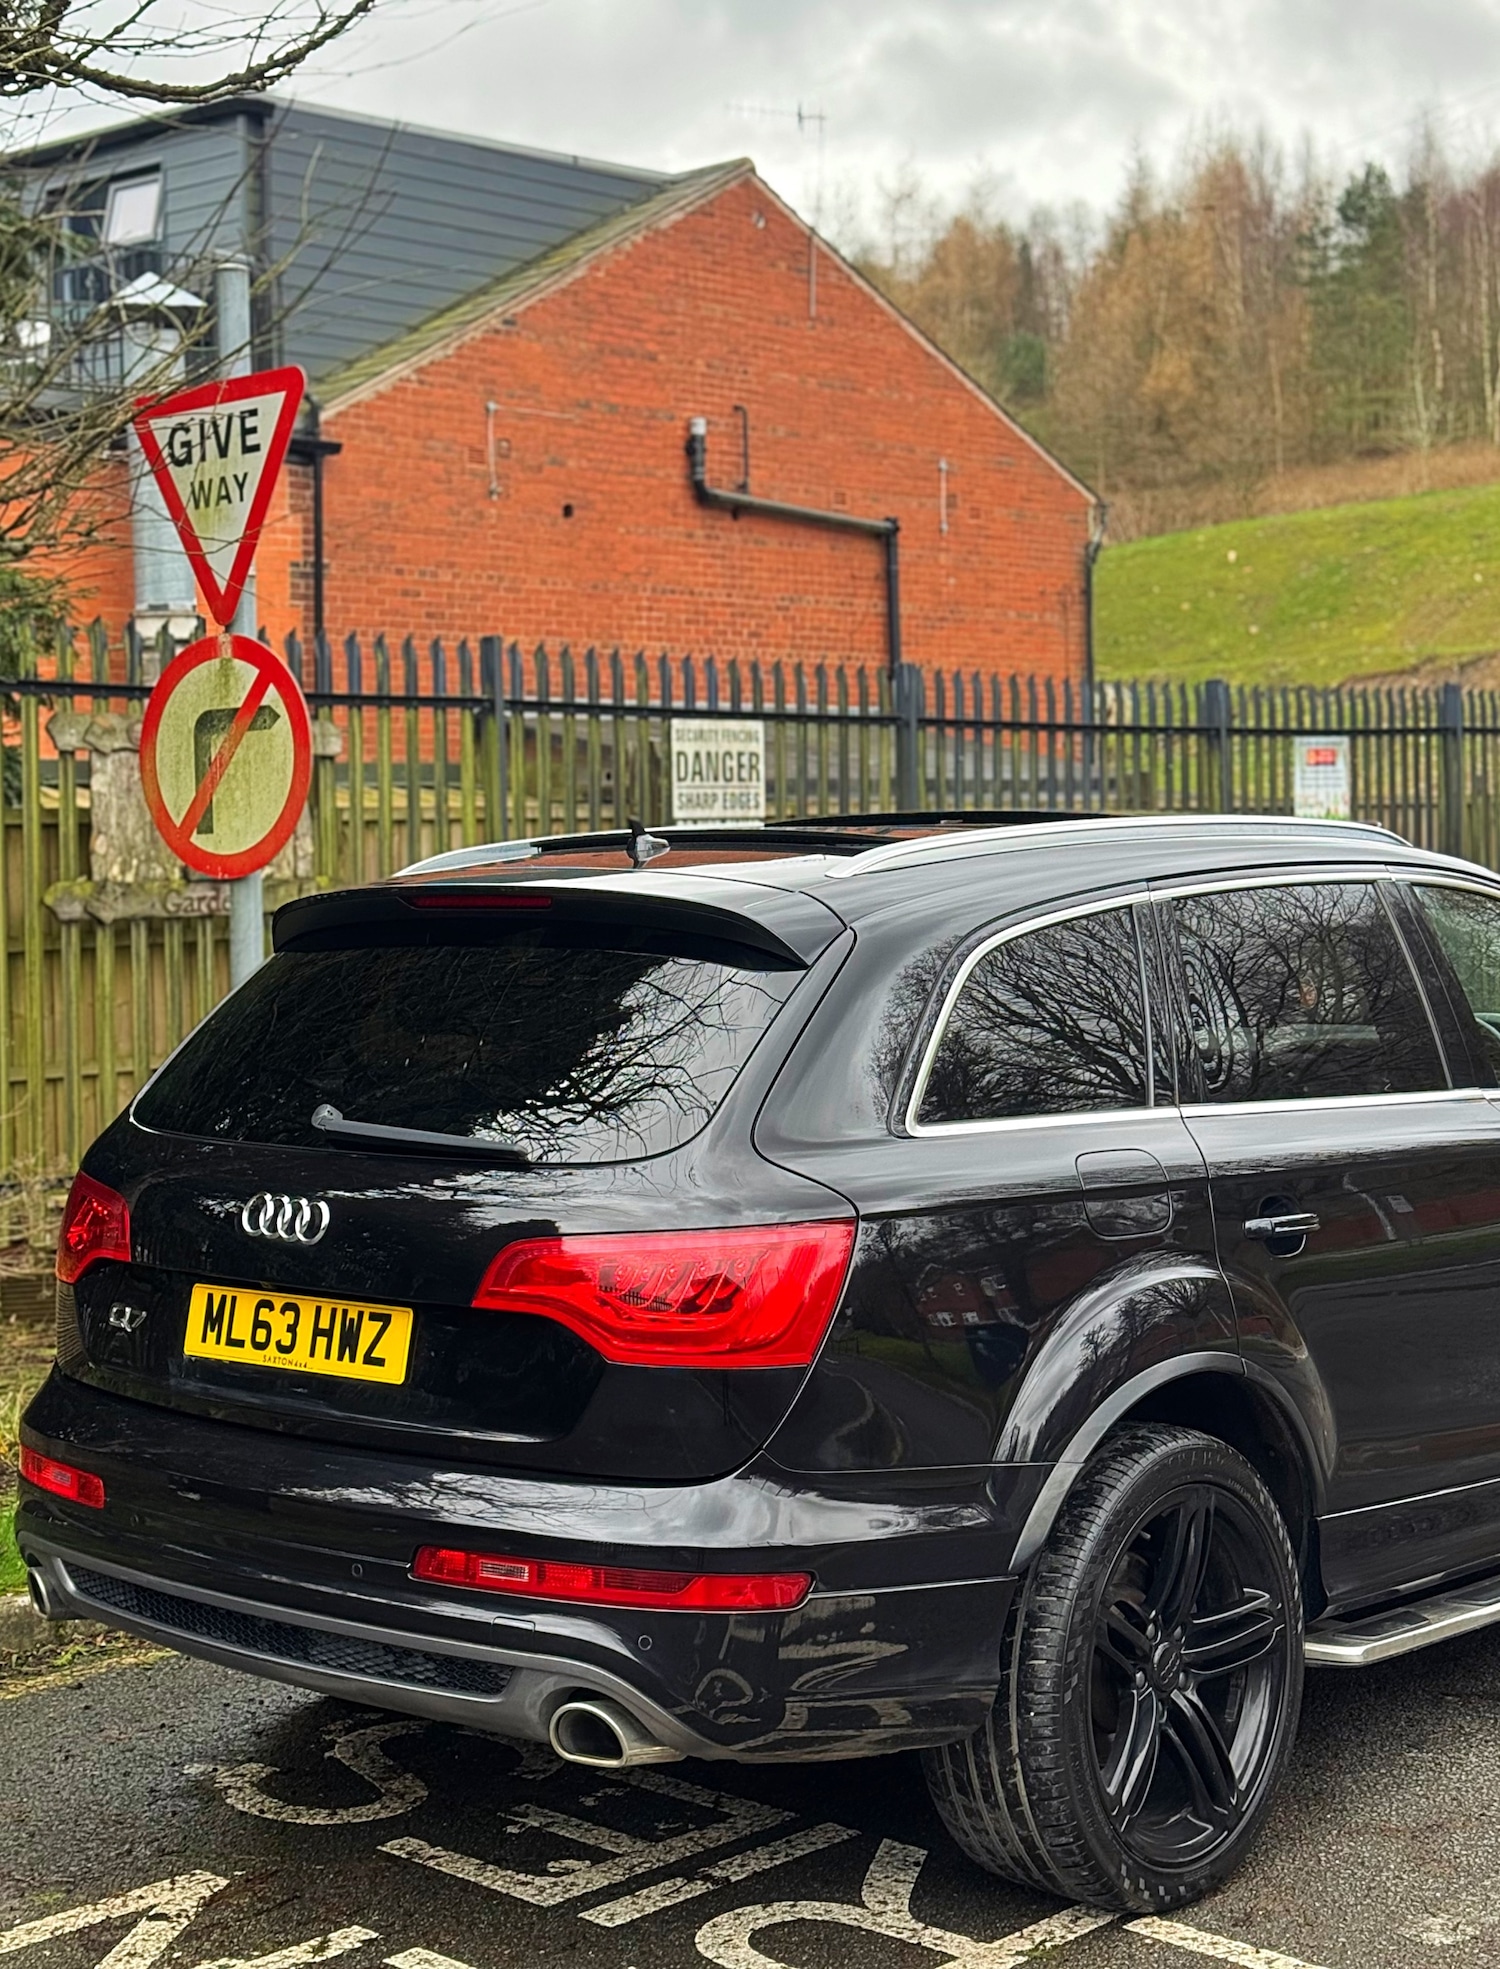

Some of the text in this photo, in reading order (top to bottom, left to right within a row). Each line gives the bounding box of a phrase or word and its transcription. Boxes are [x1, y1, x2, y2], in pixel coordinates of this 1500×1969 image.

[168, 408, 261, 467] GIVE
[190, 472, 249, 510] WAY
[676, 750, 760, 782] DANGER
[677, 792, 760, 810] SHARP EDGES
[109, 1302, 147, 1332] Q7
[201, 1292, 392, 1367] ML63 HWZ
